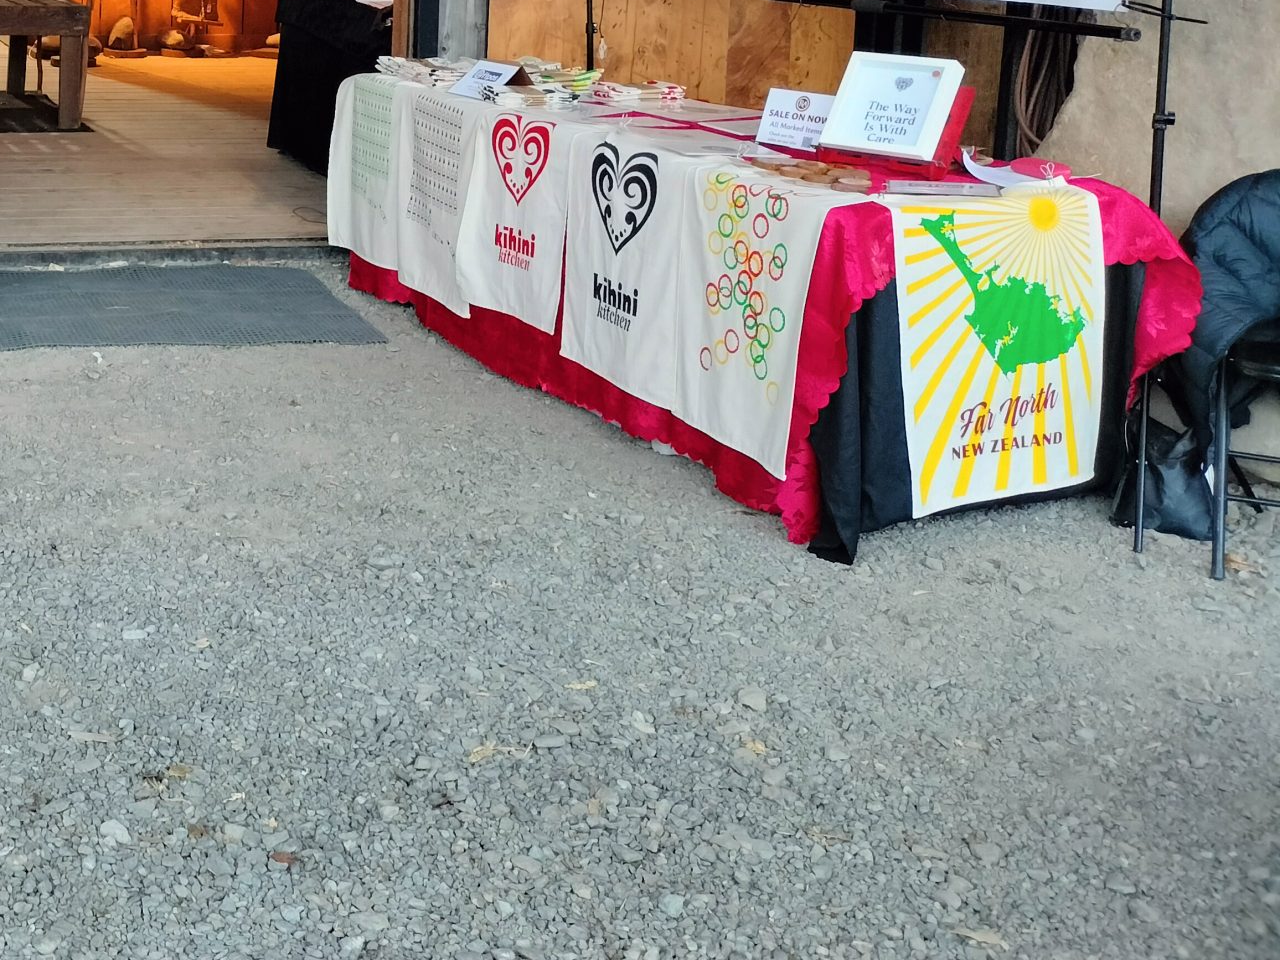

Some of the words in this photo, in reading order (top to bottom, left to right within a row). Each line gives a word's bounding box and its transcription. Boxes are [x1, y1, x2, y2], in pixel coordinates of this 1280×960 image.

[769, 109, 790, 119] SALE
[791, 112, 805, 121] ON
[869, 100, 889, 112] The
[894, 103, 920, 116] Way
[864, 111, 917, 126] Forward
[864, 121, 874, 131] Is
[880, 123, 907, 136] With
[866, 133, 895, 144] Care
[498, 249, 530, 271] kitchen
[597, 301, 631, 332] kitchen
[960, 401, 996, 438] Far
[999, 382, 1059, 427] North
[952, 441, 985, 460] NEW
[991, 431, 1063, 453] ZEALAND
